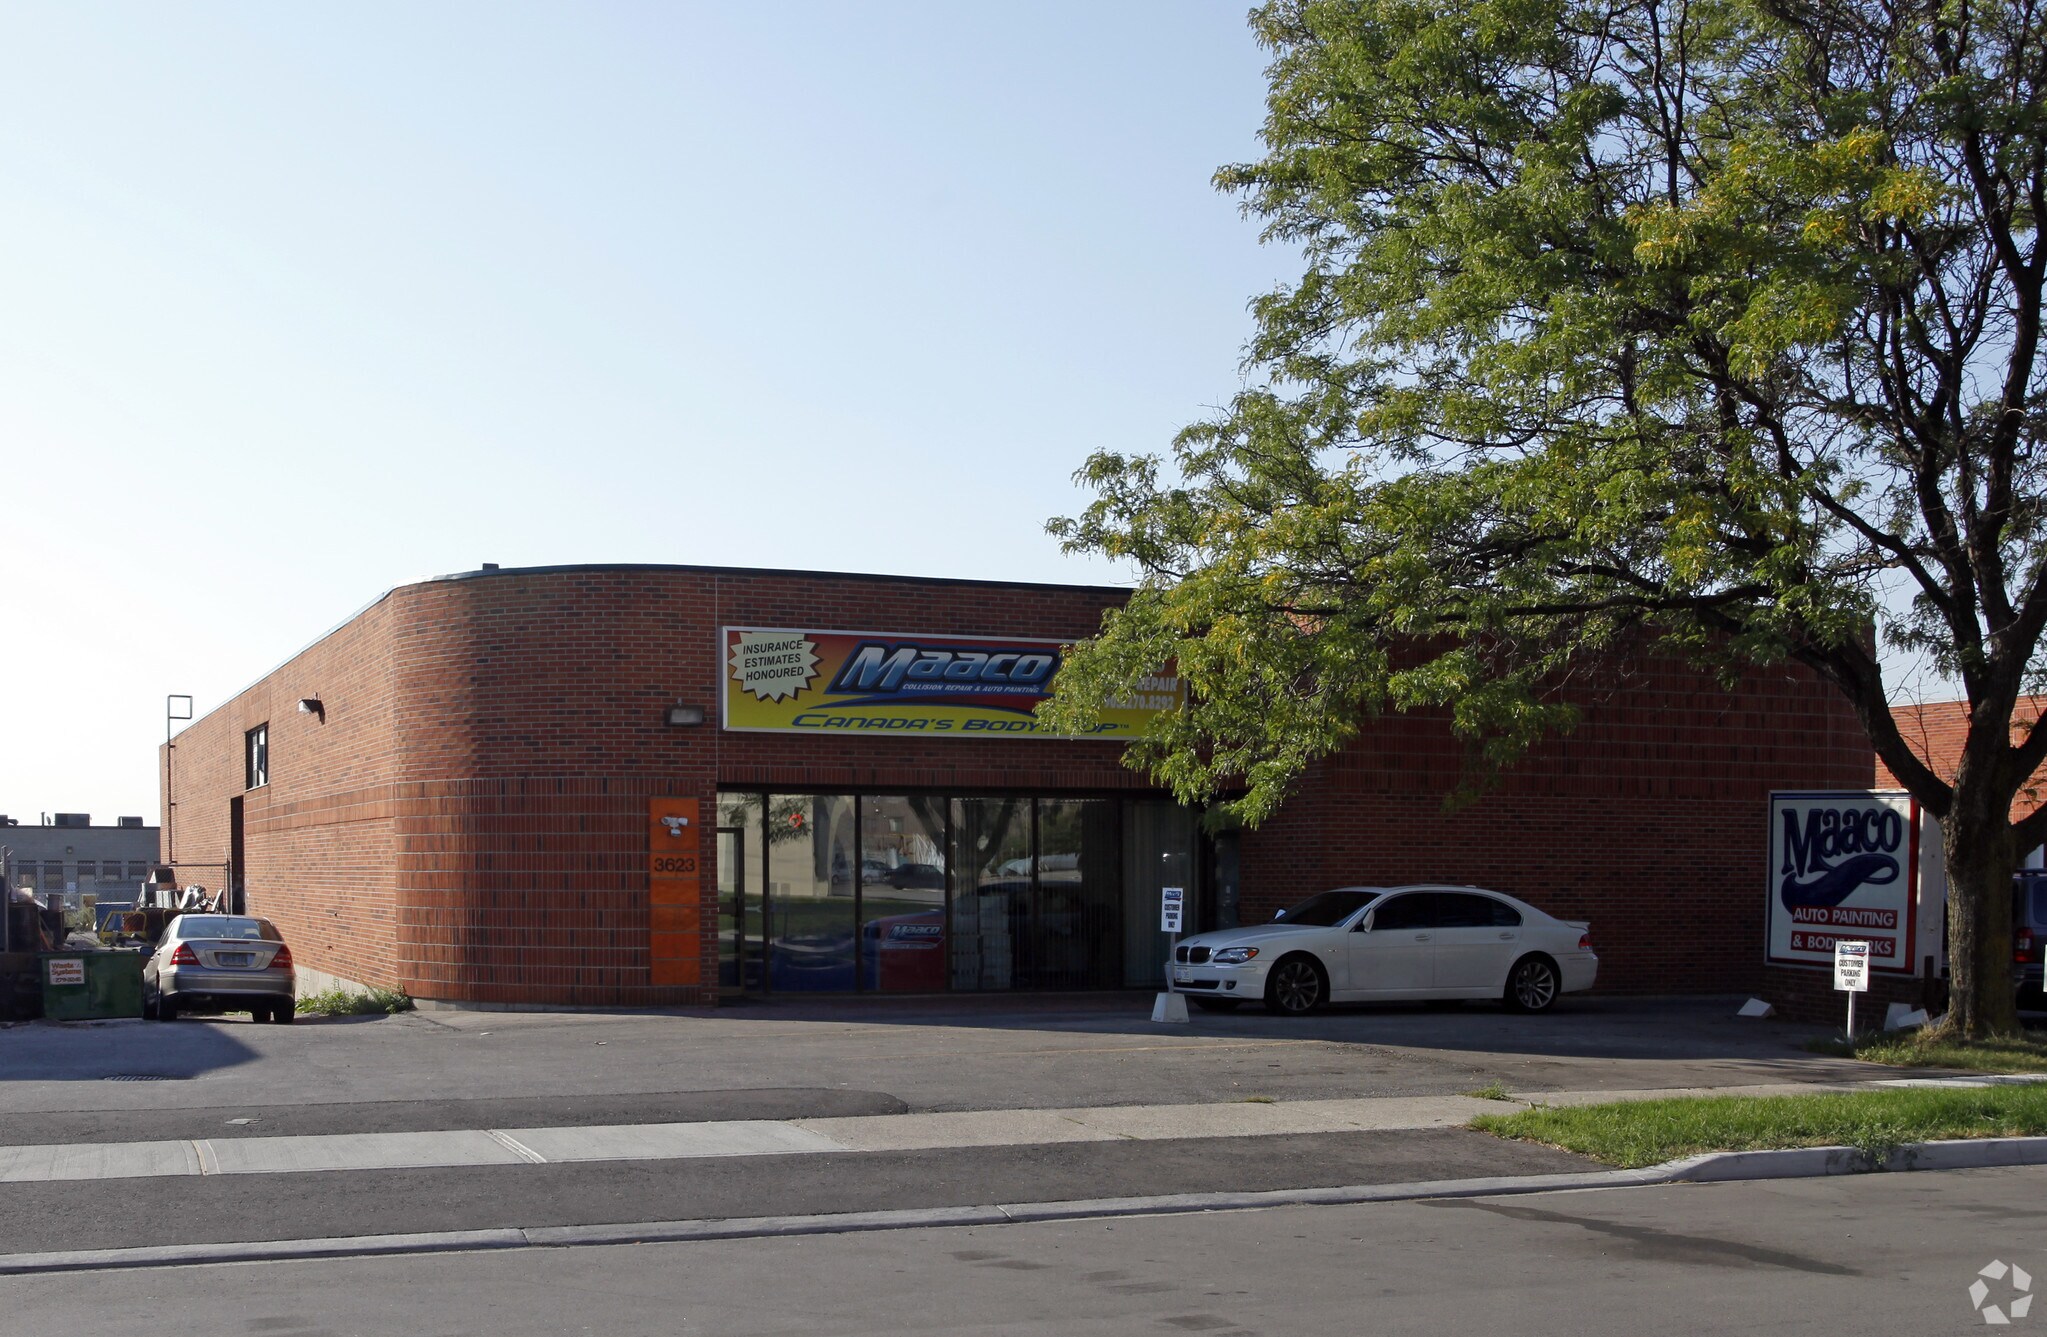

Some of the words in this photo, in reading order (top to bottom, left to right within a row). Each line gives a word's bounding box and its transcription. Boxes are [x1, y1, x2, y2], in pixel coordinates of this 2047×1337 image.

[743, 640, 803, 654] INSURANCE
[744, 653, 801, 668] ESTIMATES
[840, 646, 1054, 689] Maaco
[746, 666, 804, 681] HONOURED
[902, 683, 942, 691] COLLISION
[944, 684, 973, 692] REPAIR
[982, 685, 1002, 693] AUTO
[1003, 686, 1039, 694] PAINTING
[792, 713, 954, 730] CANADA'S
[1781, 808, 1902, 877] Maaco
[654, 858, 695, 872] 3623
[1793, 907, 1829, 922] AUTO
[1832, 909, 1895, 926] PAINTING
[890, 925, 941, 937] Maaco
[1793, 934, 1802, 948] &
[1807, 935, 1892, 954] BODRKS
[1839, 959, 1864, 967] CUSTOMER
[1840, 969, 1861, 977] PARKING
[1845, 978, 1856, 987] ONLY
